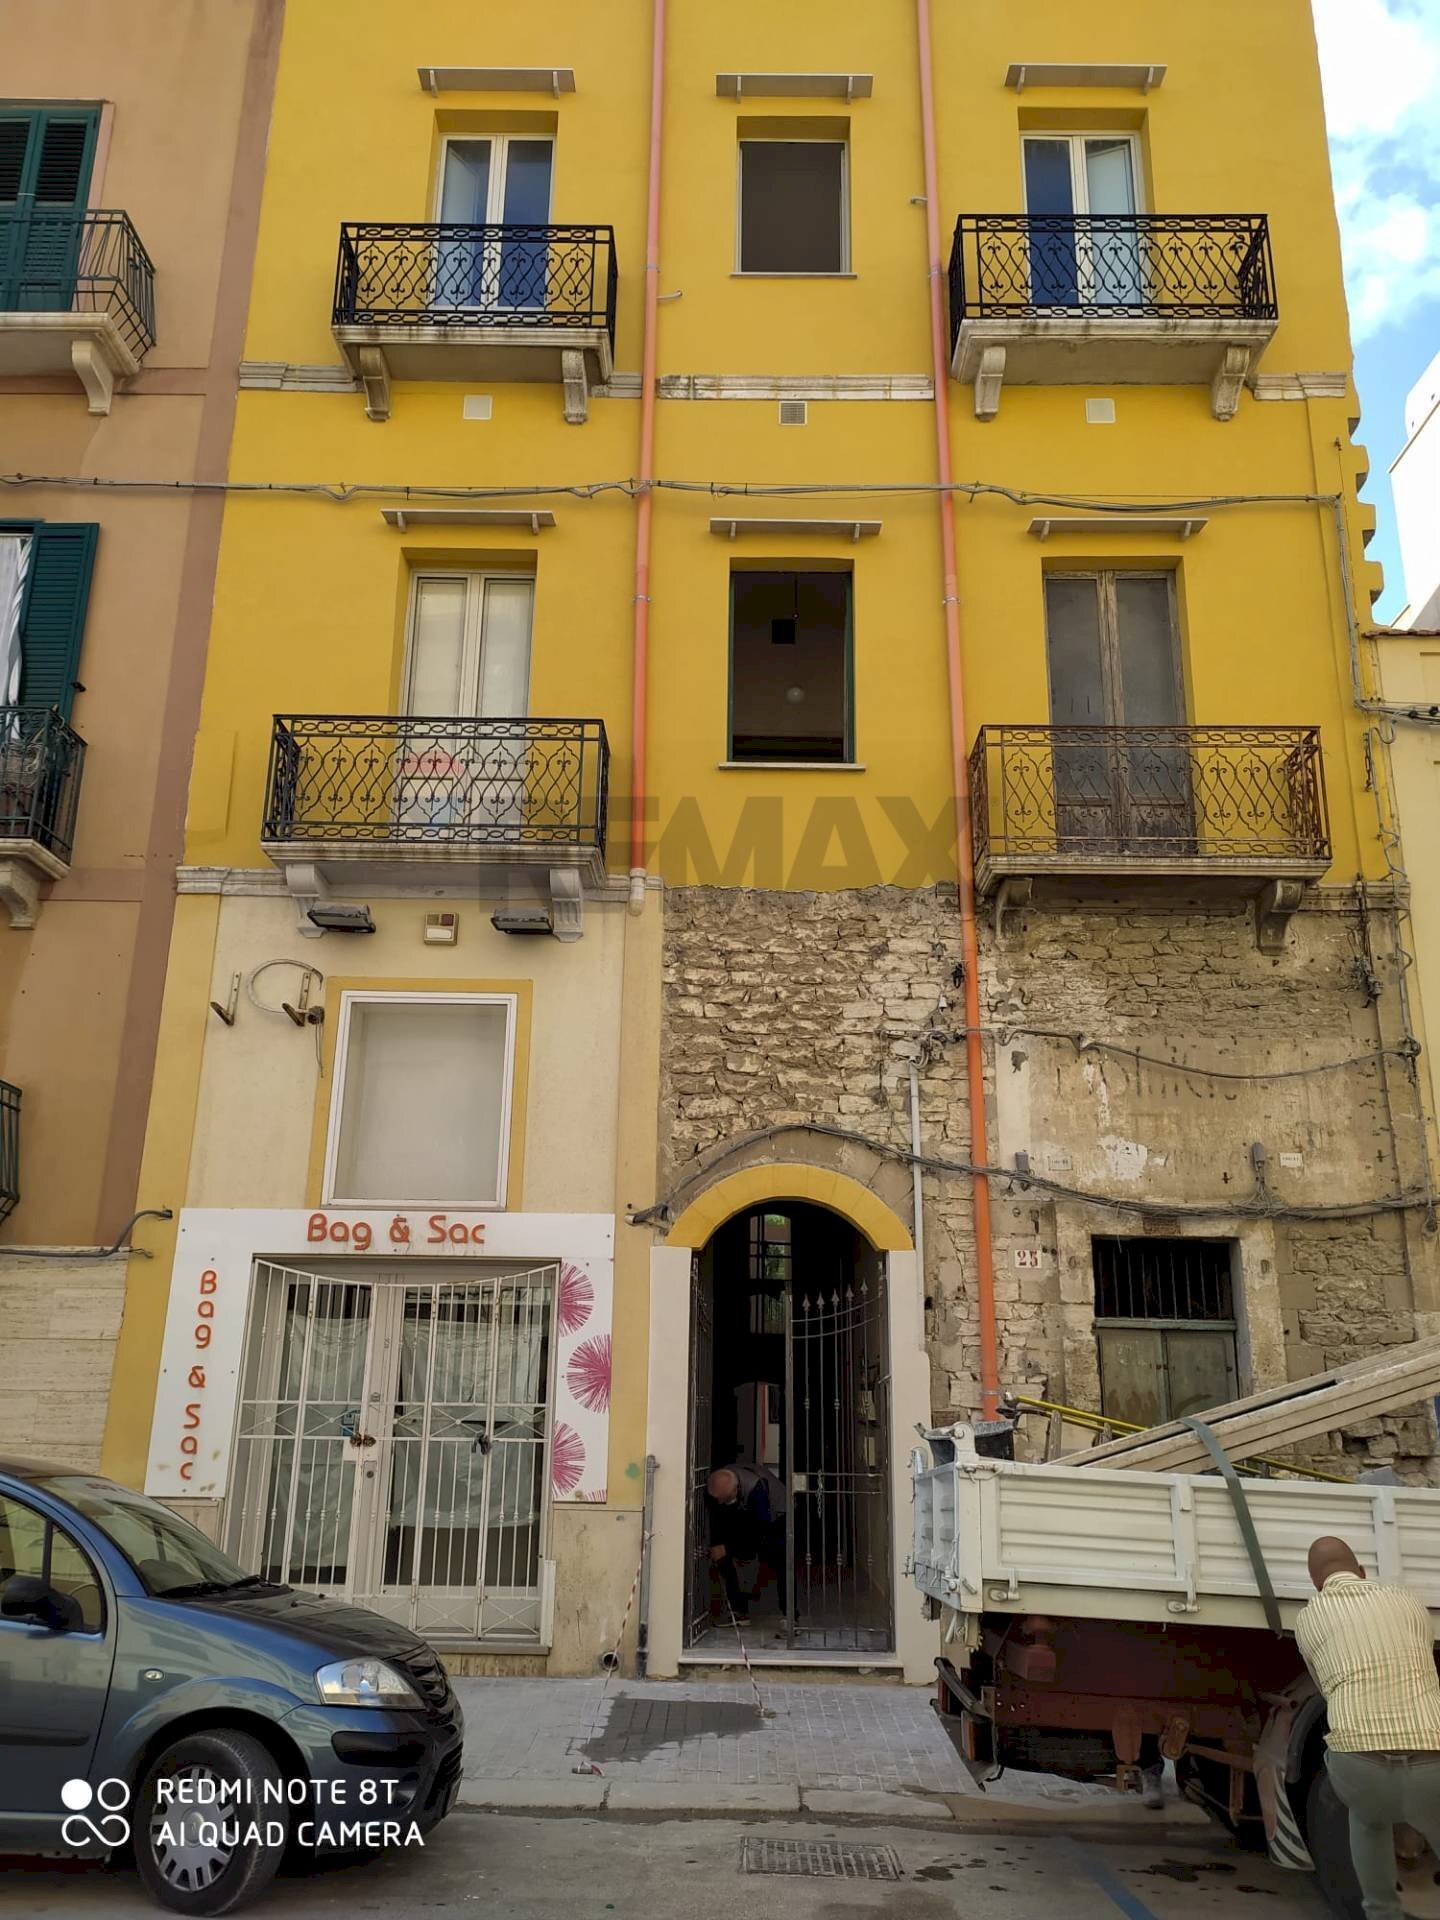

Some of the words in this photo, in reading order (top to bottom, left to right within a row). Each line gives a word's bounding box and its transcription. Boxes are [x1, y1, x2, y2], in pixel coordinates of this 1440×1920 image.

[307, 1213, 373, 1251] Bag
[389, 1217, 411, 1243] &
[427, 1215, 486, 1244] Sac
[194, 1270, 218, 1349] Bag
[188, 1365, 206, 1389] &
[179, 1403, 202, 1481] Sac
